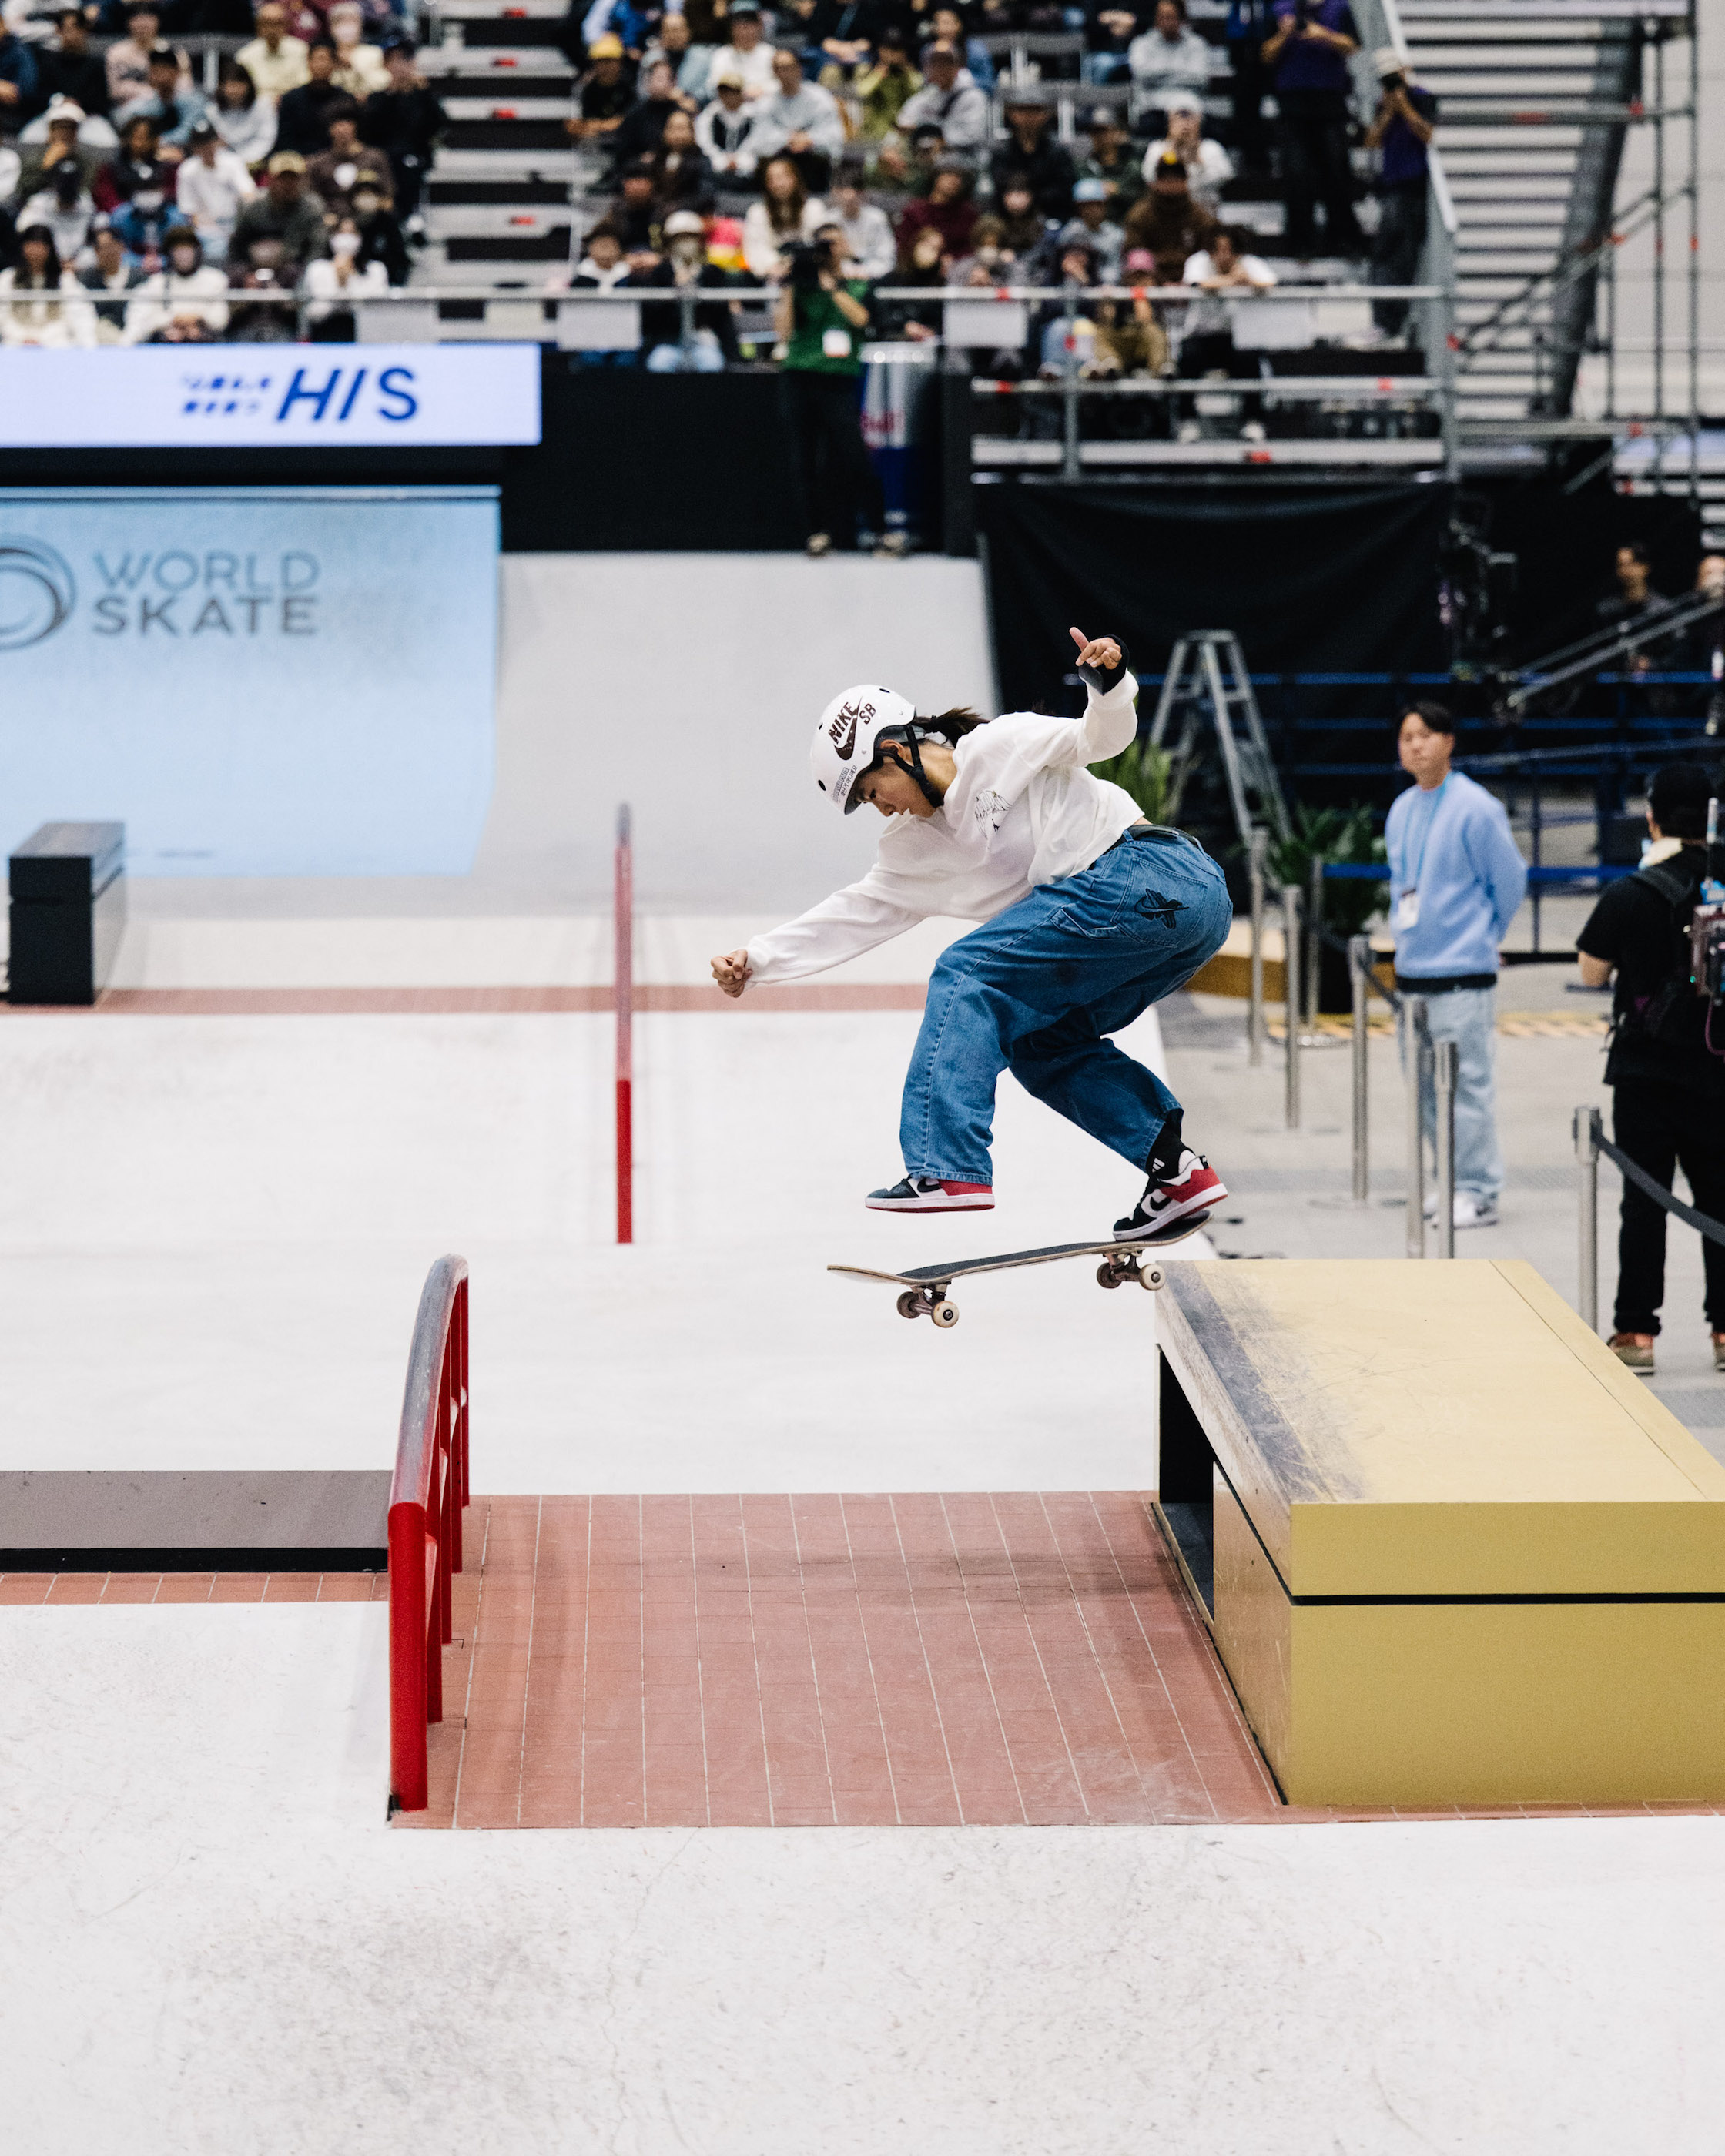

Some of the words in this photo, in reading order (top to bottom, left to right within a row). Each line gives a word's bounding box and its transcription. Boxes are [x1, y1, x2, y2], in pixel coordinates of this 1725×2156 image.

[276, 365, 418, 422] HIS
[92, 549, 320, 593] WORLD
[92, 594, 320, 637] SKATE
[828, 701, 858, 745] NIKE
[859, 703, 876, 725] SB
